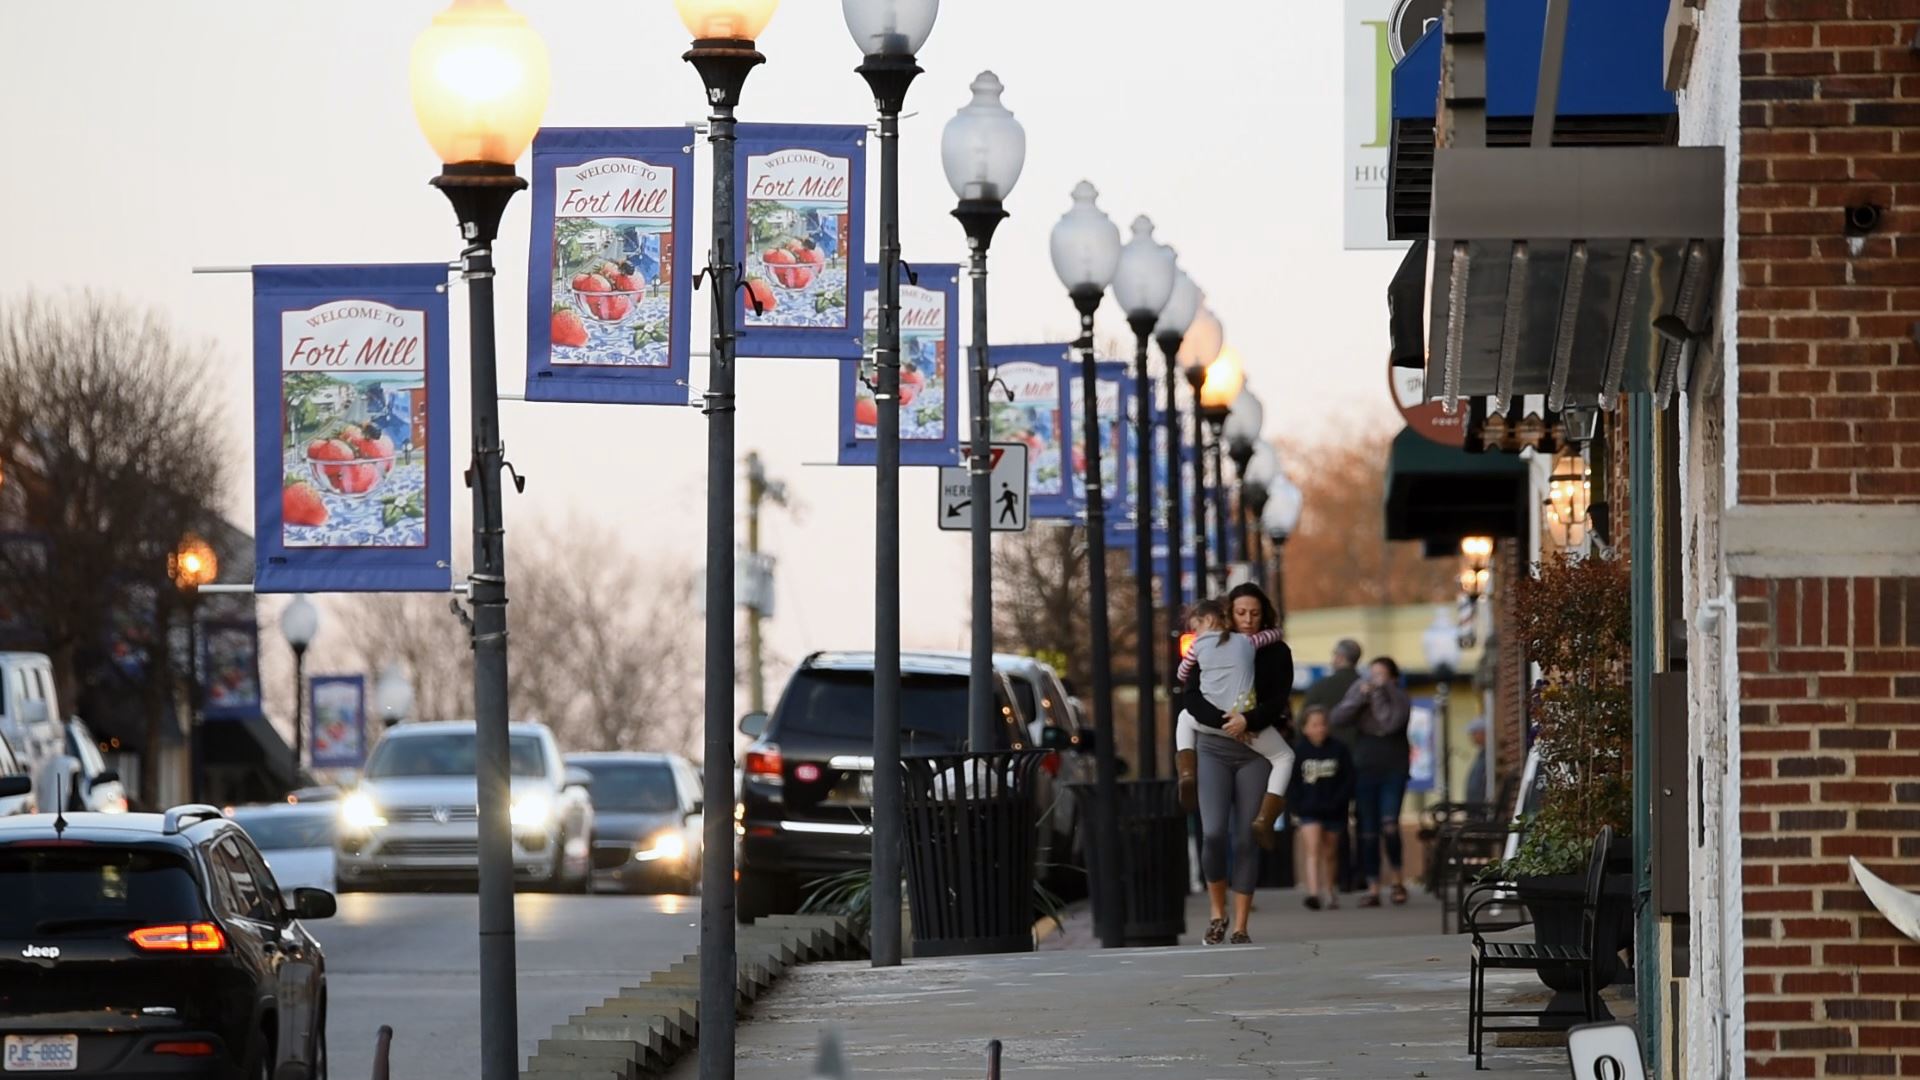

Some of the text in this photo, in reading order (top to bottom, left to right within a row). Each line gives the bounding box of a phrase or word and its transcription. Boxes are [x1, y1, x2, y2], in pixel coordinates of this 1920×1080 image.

[765, 154, 835, 170] WELCOME TO
[576, 163, 657, 182] WELCOME TO
[752, 174, 844, 198] Fort Mill
[561, 187, 668, 214] Fort Mill
[306, 307, 405, 328] WELCOME TO
[902, 307, 941, 327] Mill
[289, 336, 419, 367] Fort Mill
[22, 944, 60, 958] Jeep
